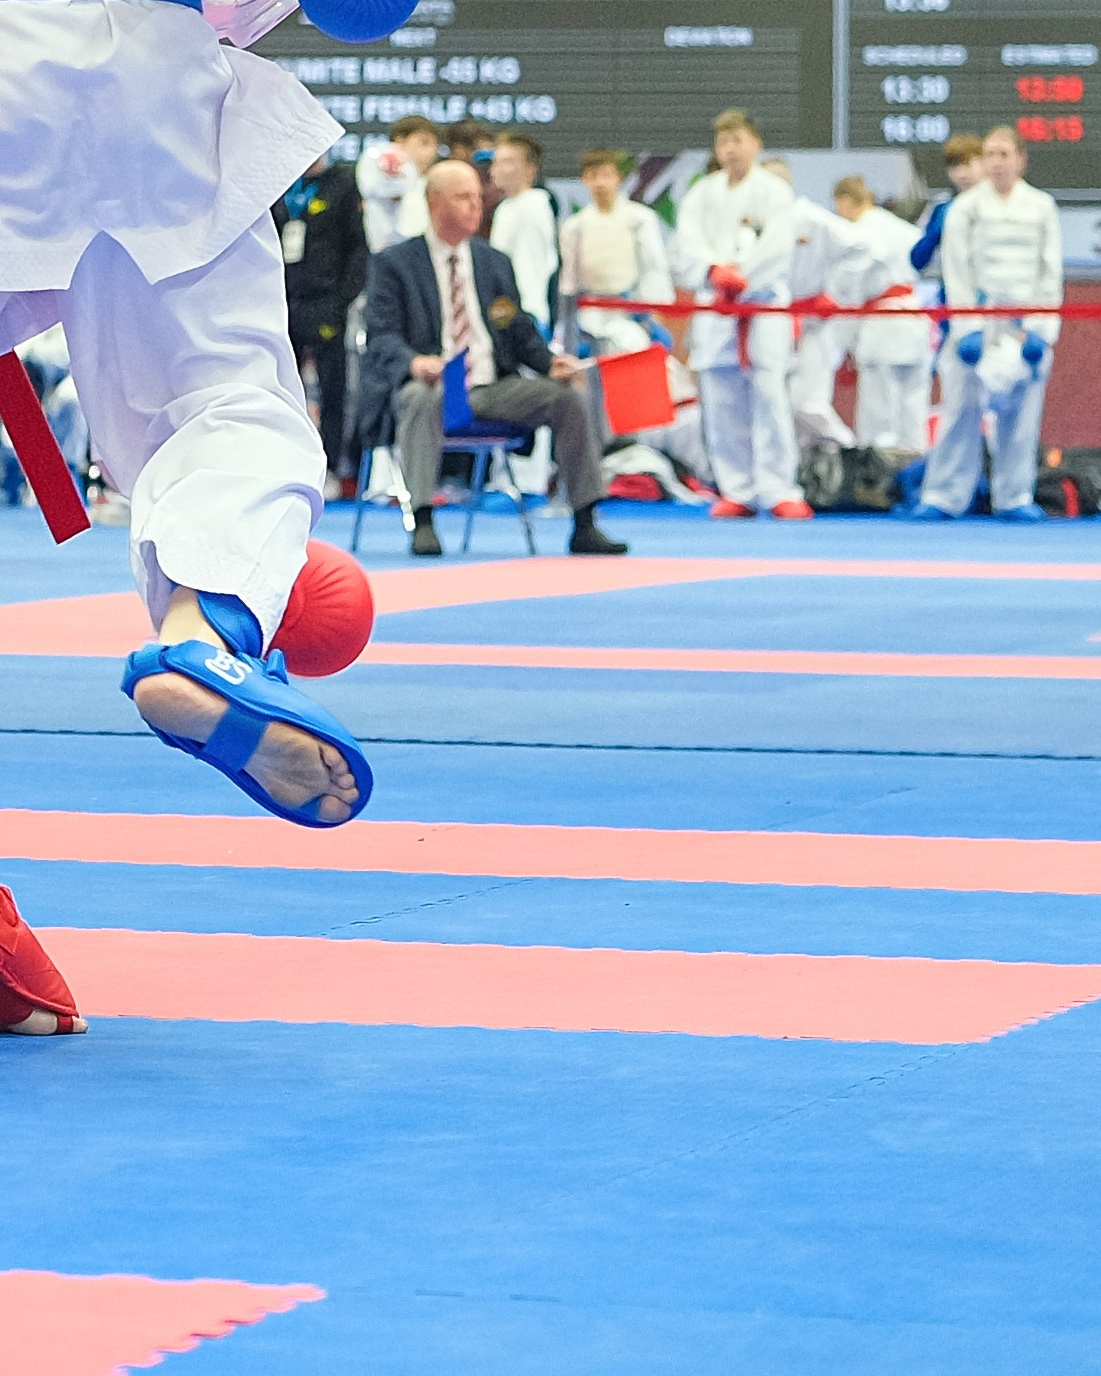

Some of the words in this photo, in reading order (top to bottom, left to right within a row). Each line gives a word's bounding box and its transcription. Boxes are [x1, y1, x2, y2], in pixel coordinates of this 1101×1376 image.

[363, 56, 437, 84] MALE
[477, 56, 520, 83] KG
[363, 95, 466, 123] FEMALE
[515, 94, 557, 122] KG
[204, 648, 252, 686] BS
